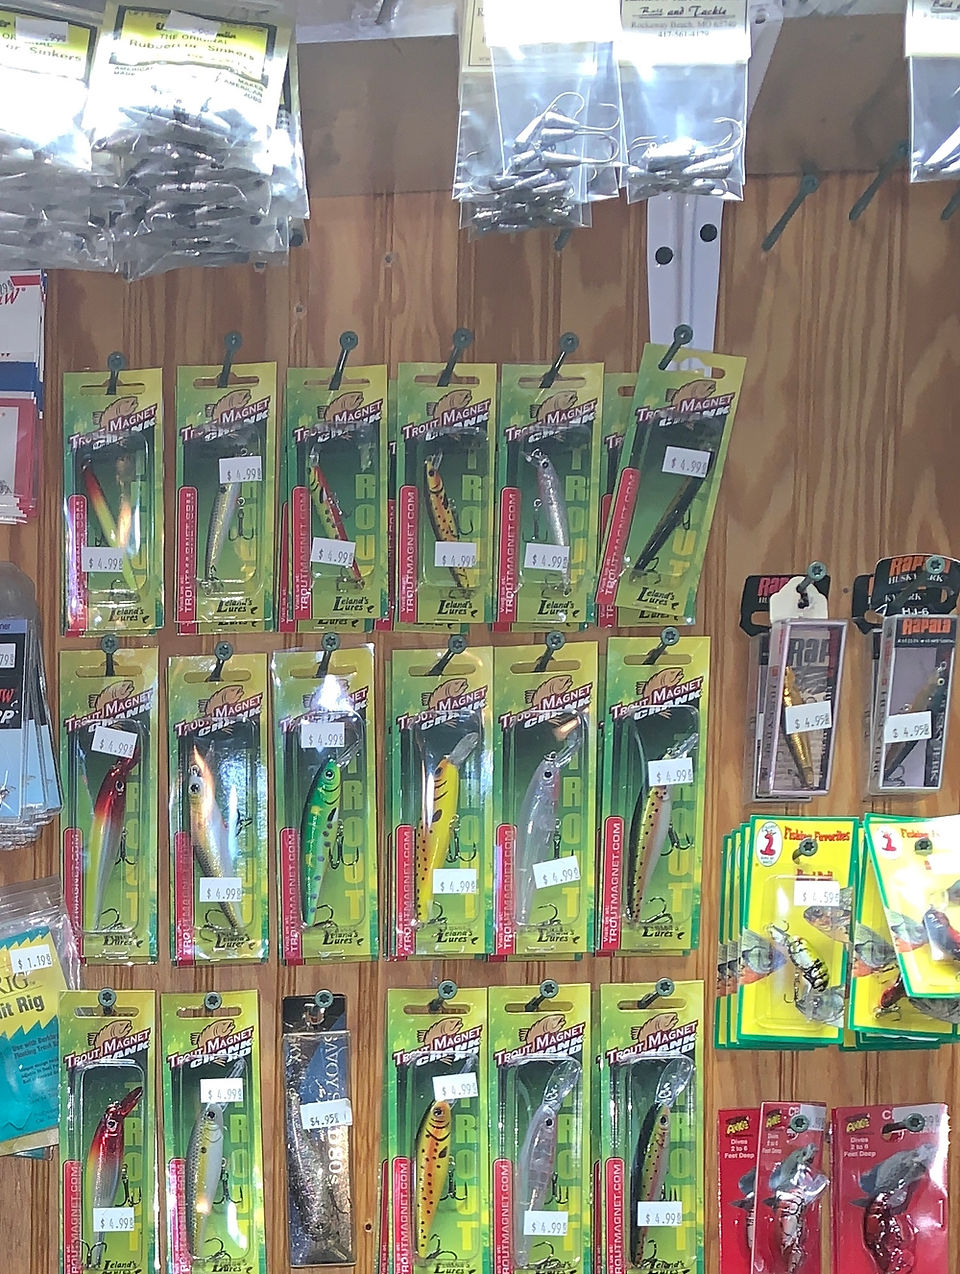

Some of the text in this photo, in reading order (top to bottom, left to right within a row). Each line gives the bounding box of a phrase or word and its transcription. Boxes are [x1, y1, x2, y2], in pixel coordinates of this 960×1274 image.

[667, 5, 728, 17] and Tackle
[442, 400, 491, 426] MAGNET
[18, 992, 45, 1016] Rig
[606, 1023, 698, 1066] TROUT MAGNET
